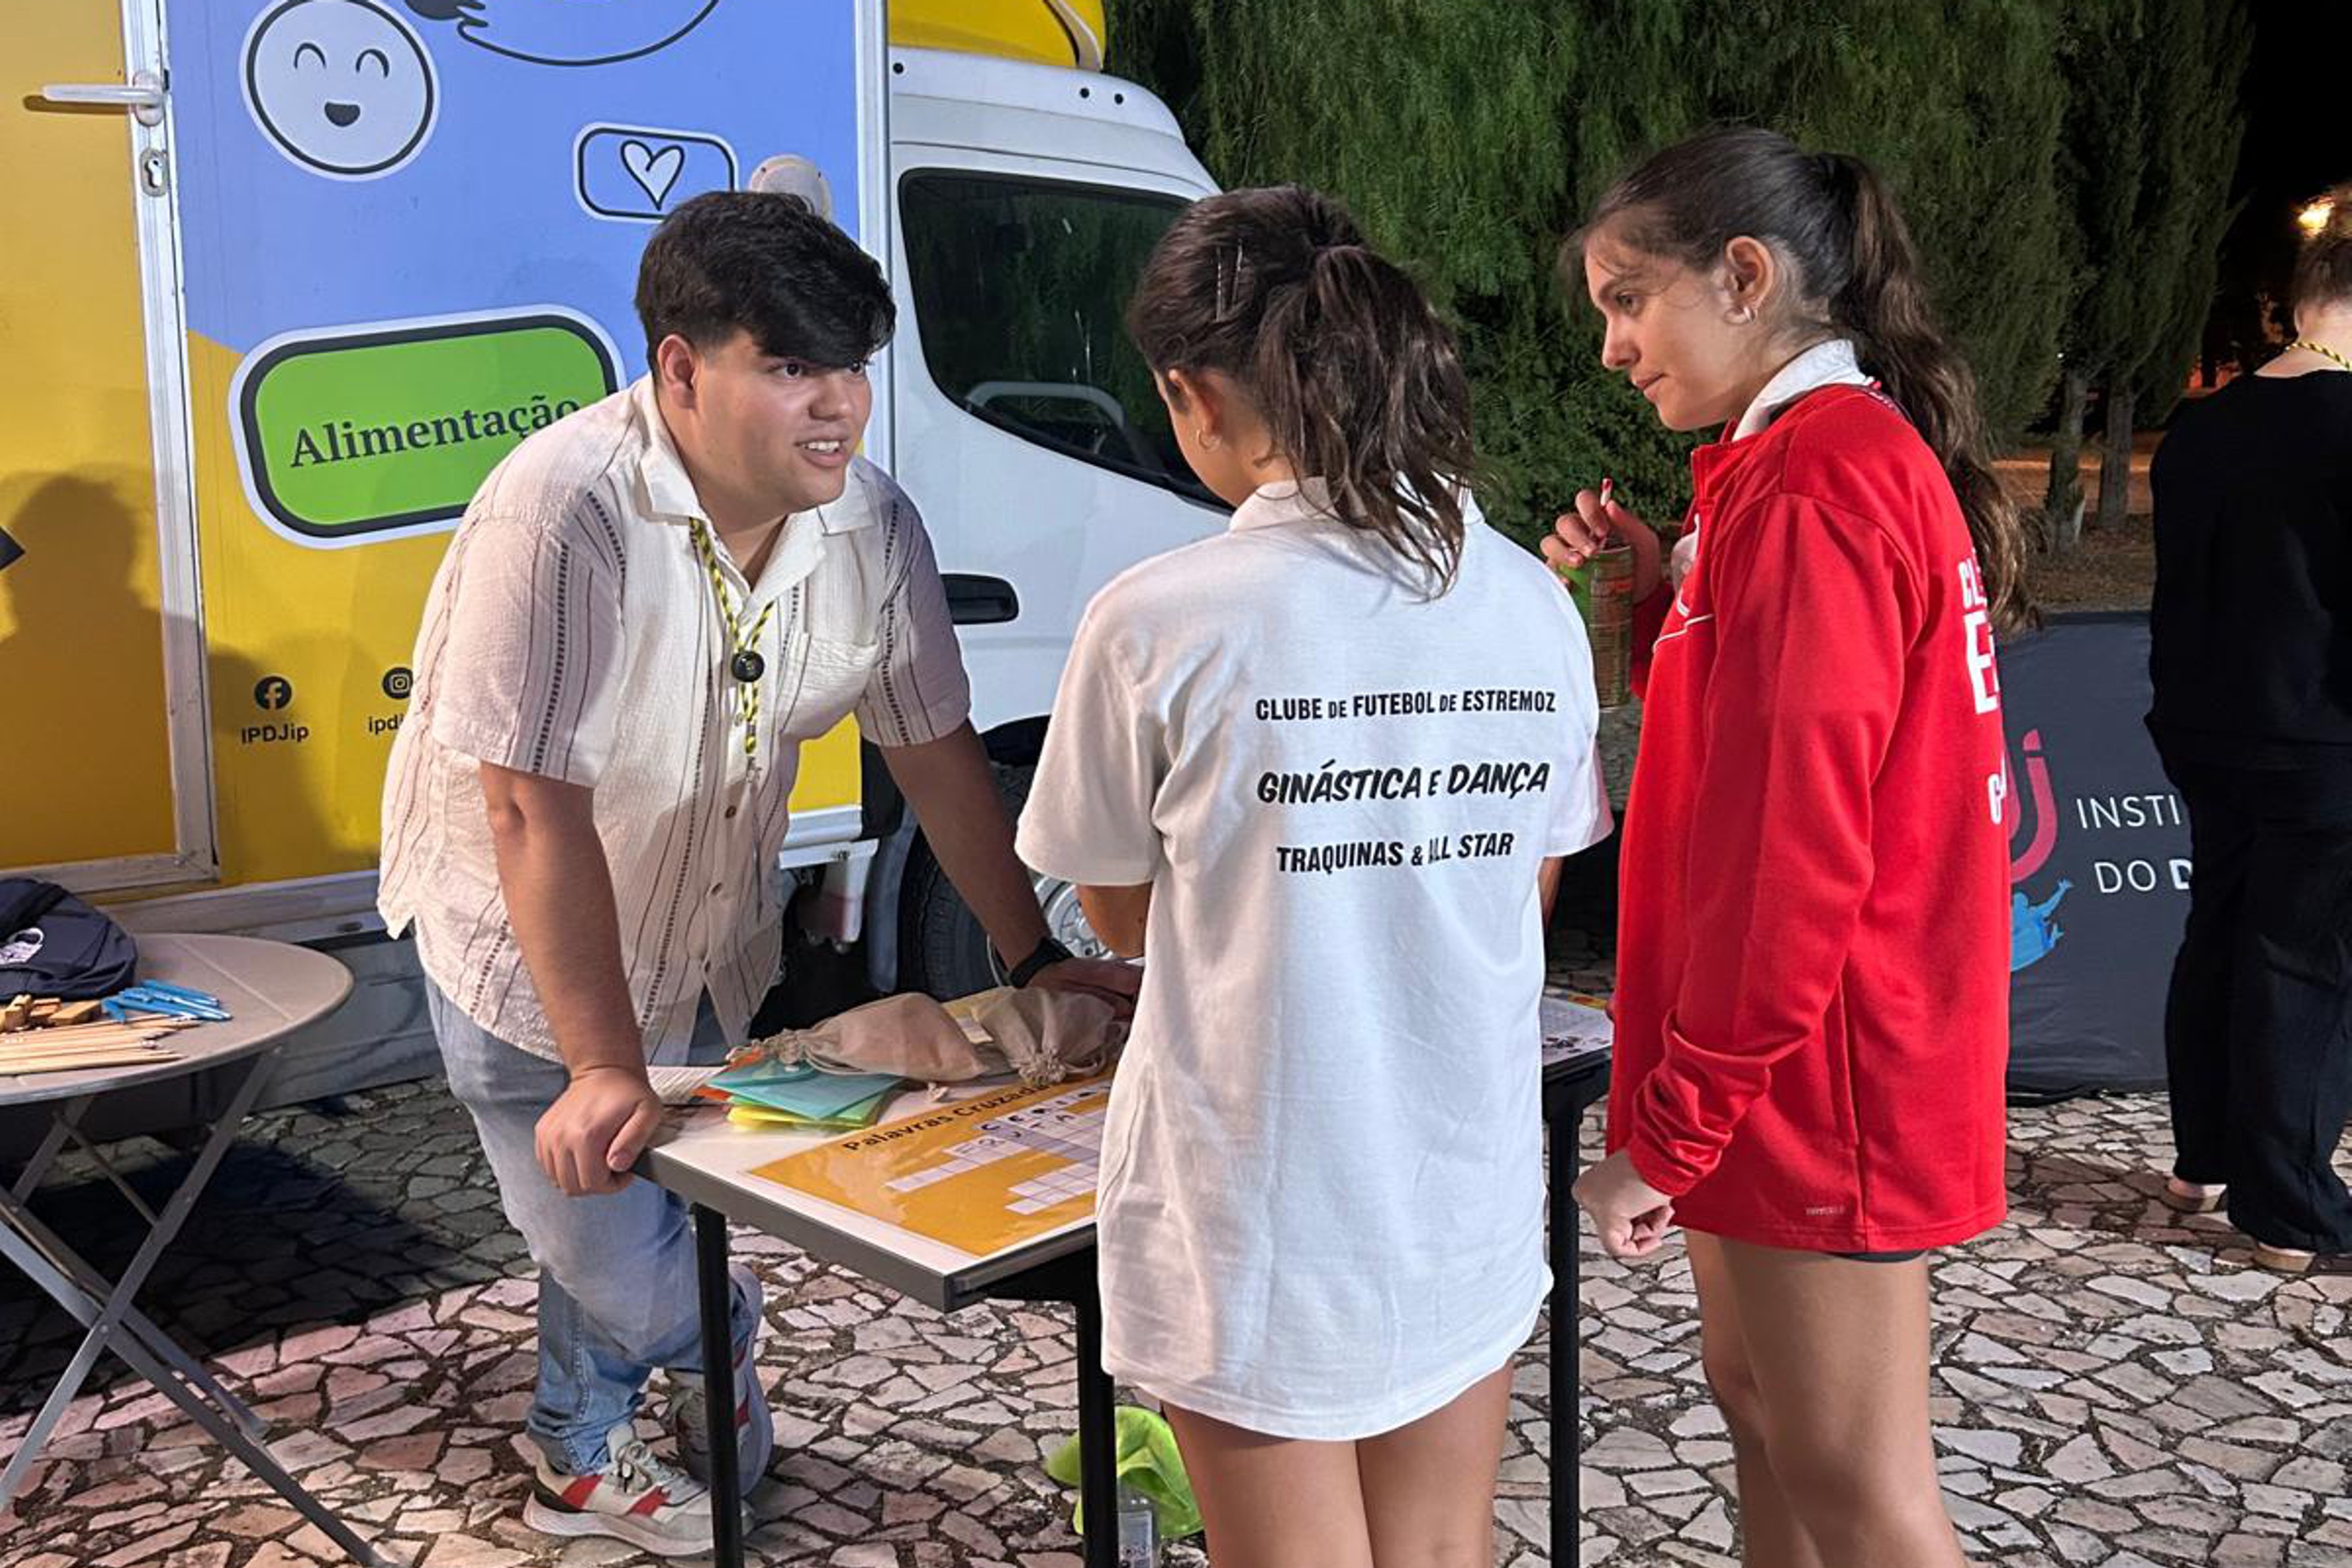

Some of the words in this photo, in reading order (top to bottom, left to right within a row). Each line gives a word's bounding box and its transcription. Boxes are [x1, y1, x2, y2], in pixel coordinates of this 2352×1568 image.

[291, 394, 580, 468] Alimentação
[1256, 698, 1323, 721] CLUBE
[1328, 700, 1347, 719] DE
[1353, 691, 1435, 717] FUTEBOL
[1439, 693, 1458, 713] DE
[1462, 689, 1557, 713] ESTREMOZ
[241, 723, 309, 744] IPDJip
[1257, 758, 1422, 804] GINÁSTICA
[1427, 770, 1442, 796] E
[1447, 762, 1551, 800] DANÇA
[2076, 794, 2180, 829] INSTI
[1276, 841, 1404, 874] TRAQUINAS
[1411, 845, 1424, 866] &
[1457, 832, 1515, 859] STAR
[2094, 859, 2157, 894] DO
[842, 1114, 953, 1151] Palavras
